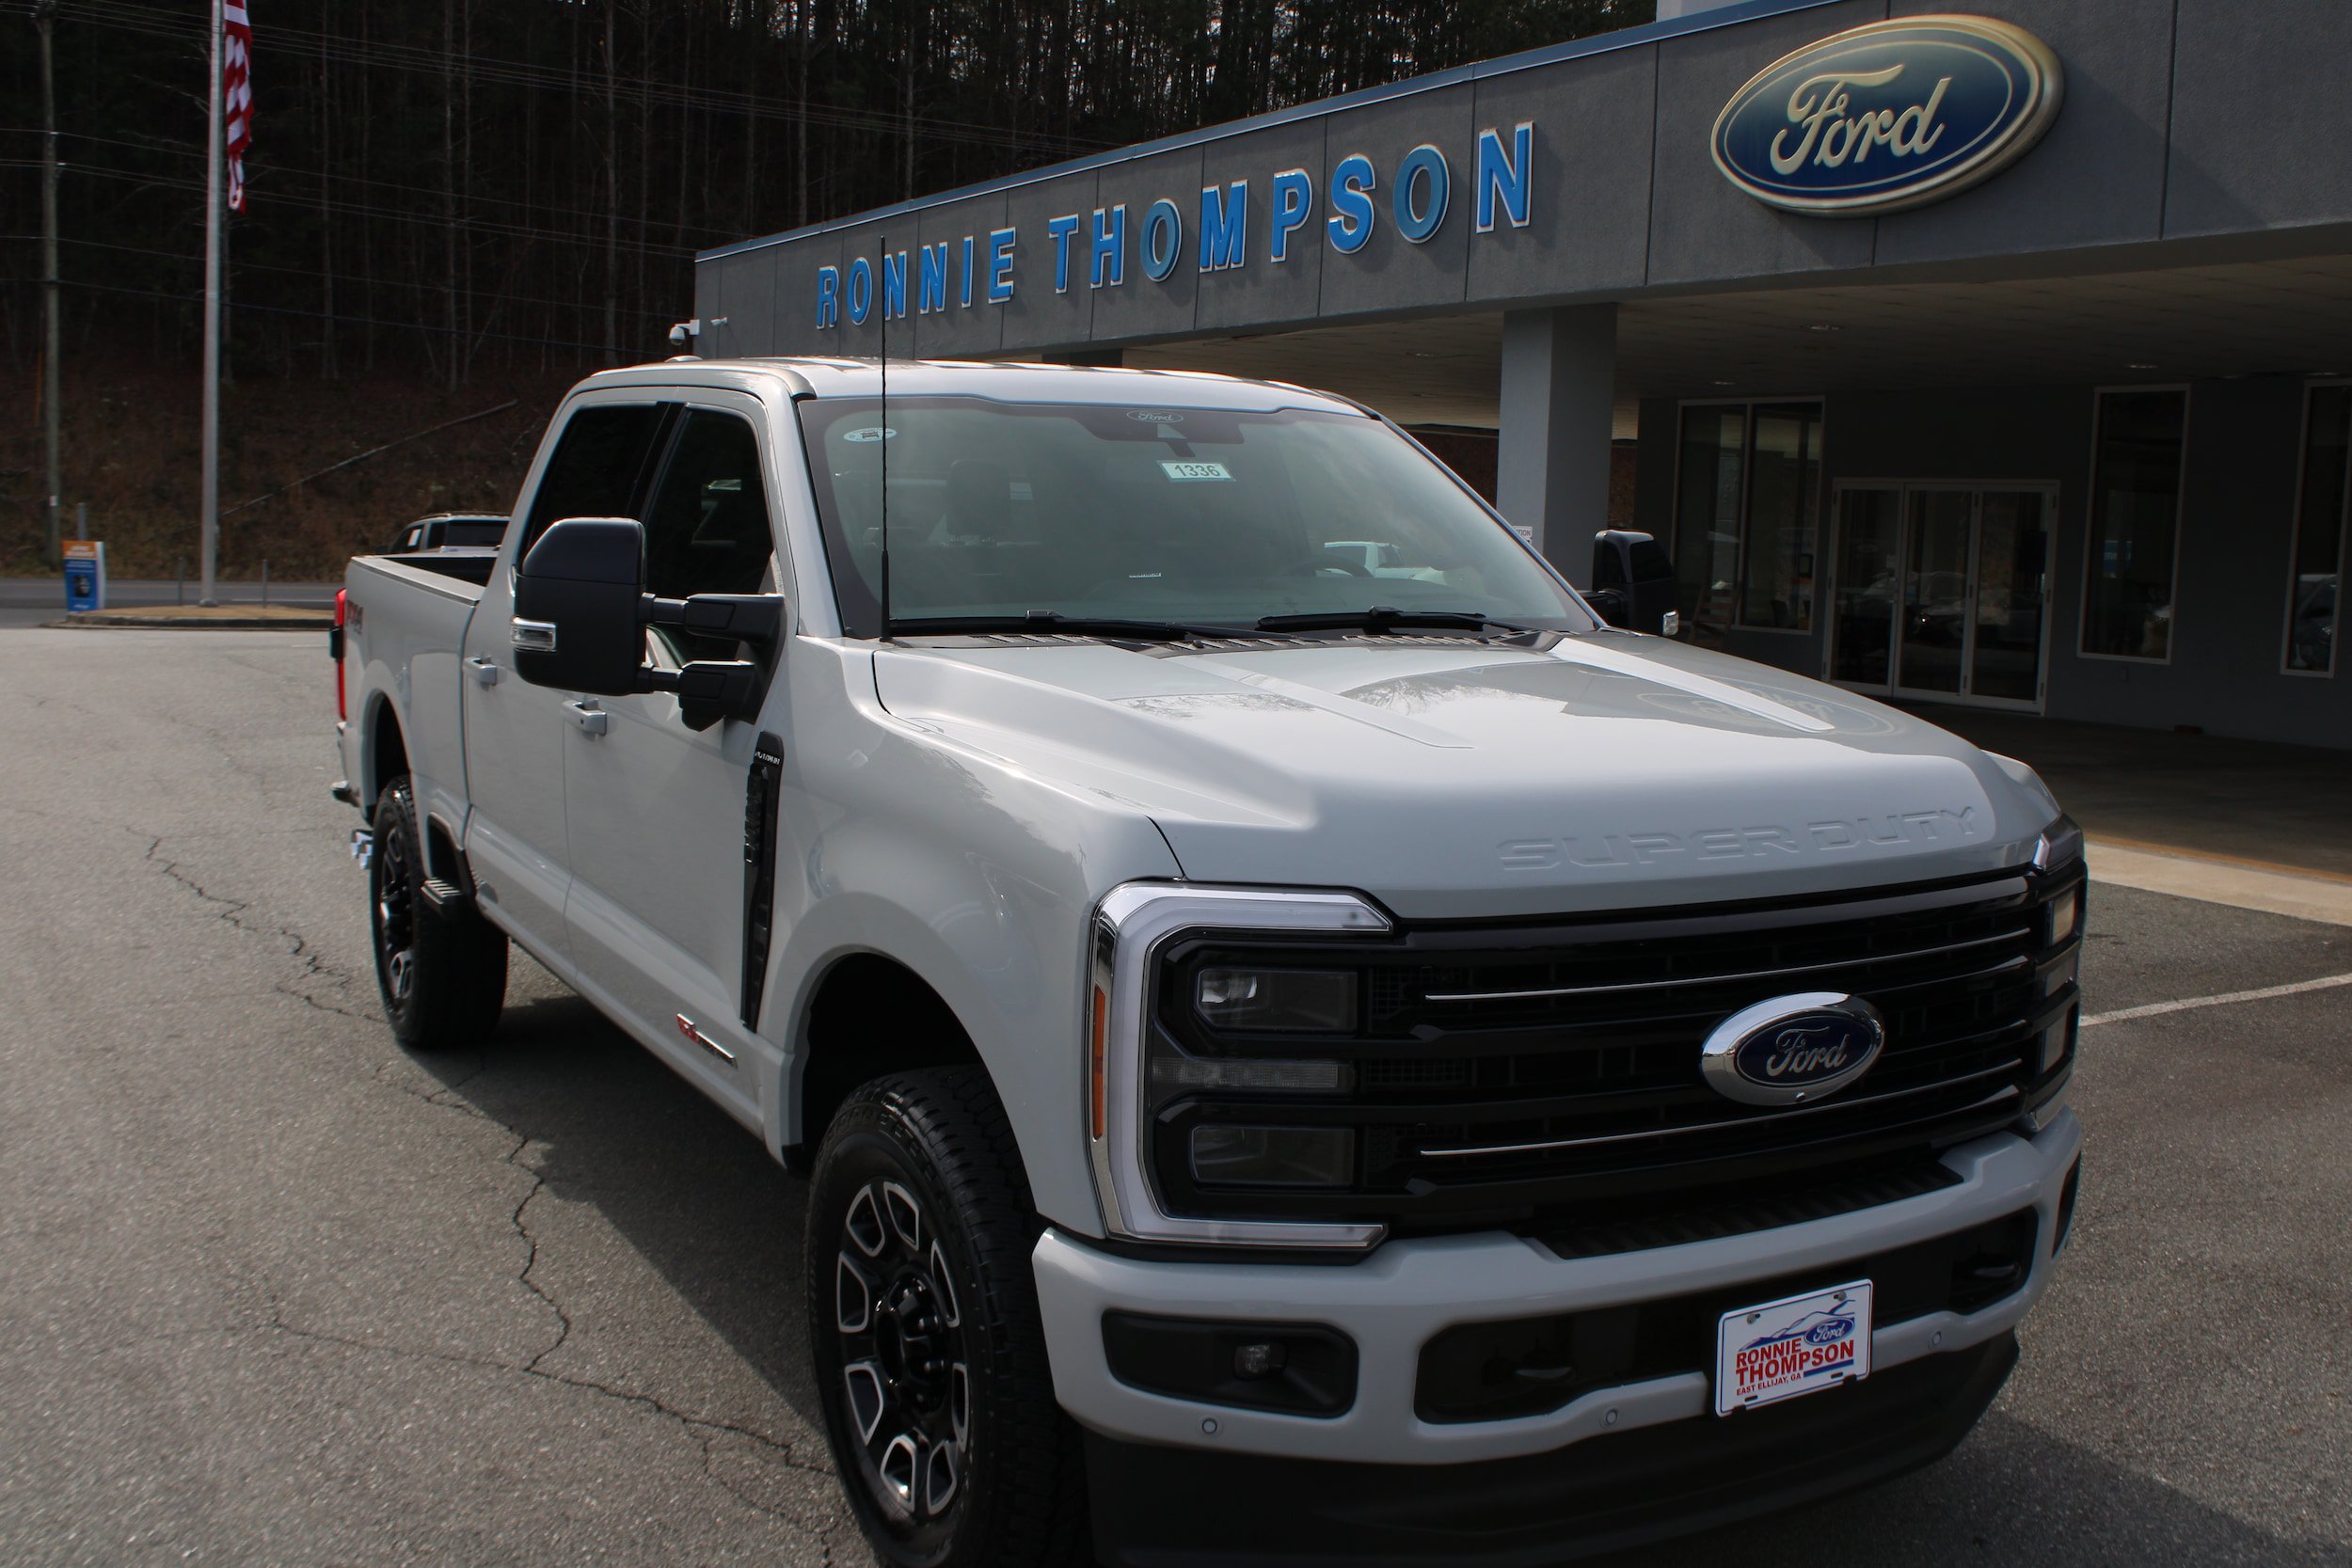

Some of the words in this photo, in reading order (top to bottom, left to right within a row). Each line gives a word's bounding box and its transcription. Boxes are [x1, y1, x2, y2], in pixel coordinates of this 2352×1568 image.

[1770, 63, 1953, 176] Ford
[816, 226, 1016, 330] RONNIE
[1048, 120, 1534, 294] THOMPSON
[1137, 412, 1175, 421] Ford
[1174, 465, 1221, 477] 1336
[1496, 825, 1799, 871] SUPER
[1806, 806, 1976, 850] DUTY
[1766, 1025, 1851, 1077] Ford
[1812, 1322, 1846, 1343] Ford
[1735, 1339, 1854, 1386] THOMPSON
[1736, 1338, 1802, 1370] RONNIE
[1737, 1385, 1756, 1396] EAST
[1790, 1372, 1802, 1382] GA
